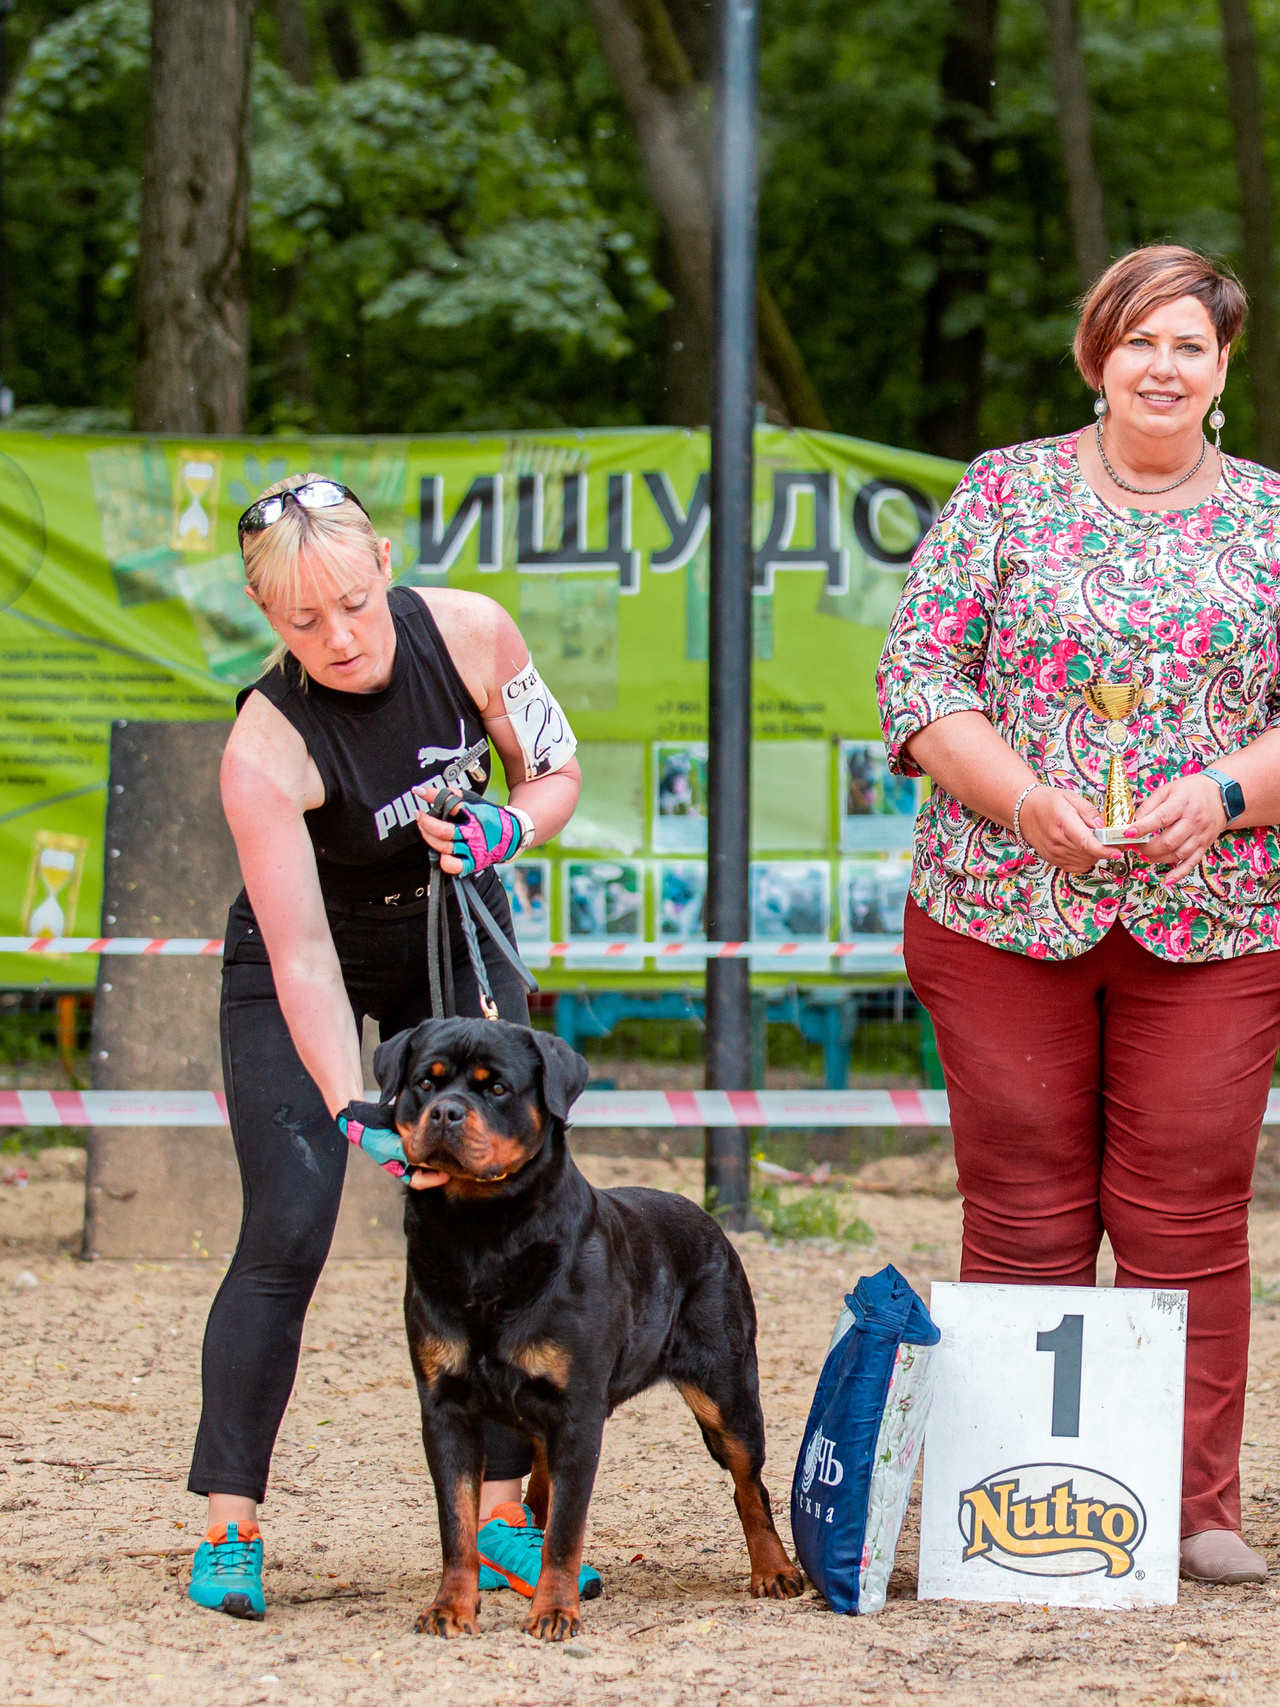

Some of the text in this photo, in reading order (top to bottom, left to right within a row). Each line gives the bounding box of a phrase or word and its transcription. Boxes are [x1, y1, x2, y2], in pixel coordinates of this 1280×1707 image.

[418, 471, 711, 595] ИЩУ
[507, 669, 537, 699] Ста
[1036, 1314, 1084, 1438] 1
[960, 1479, 1139, 1578] Nutro
